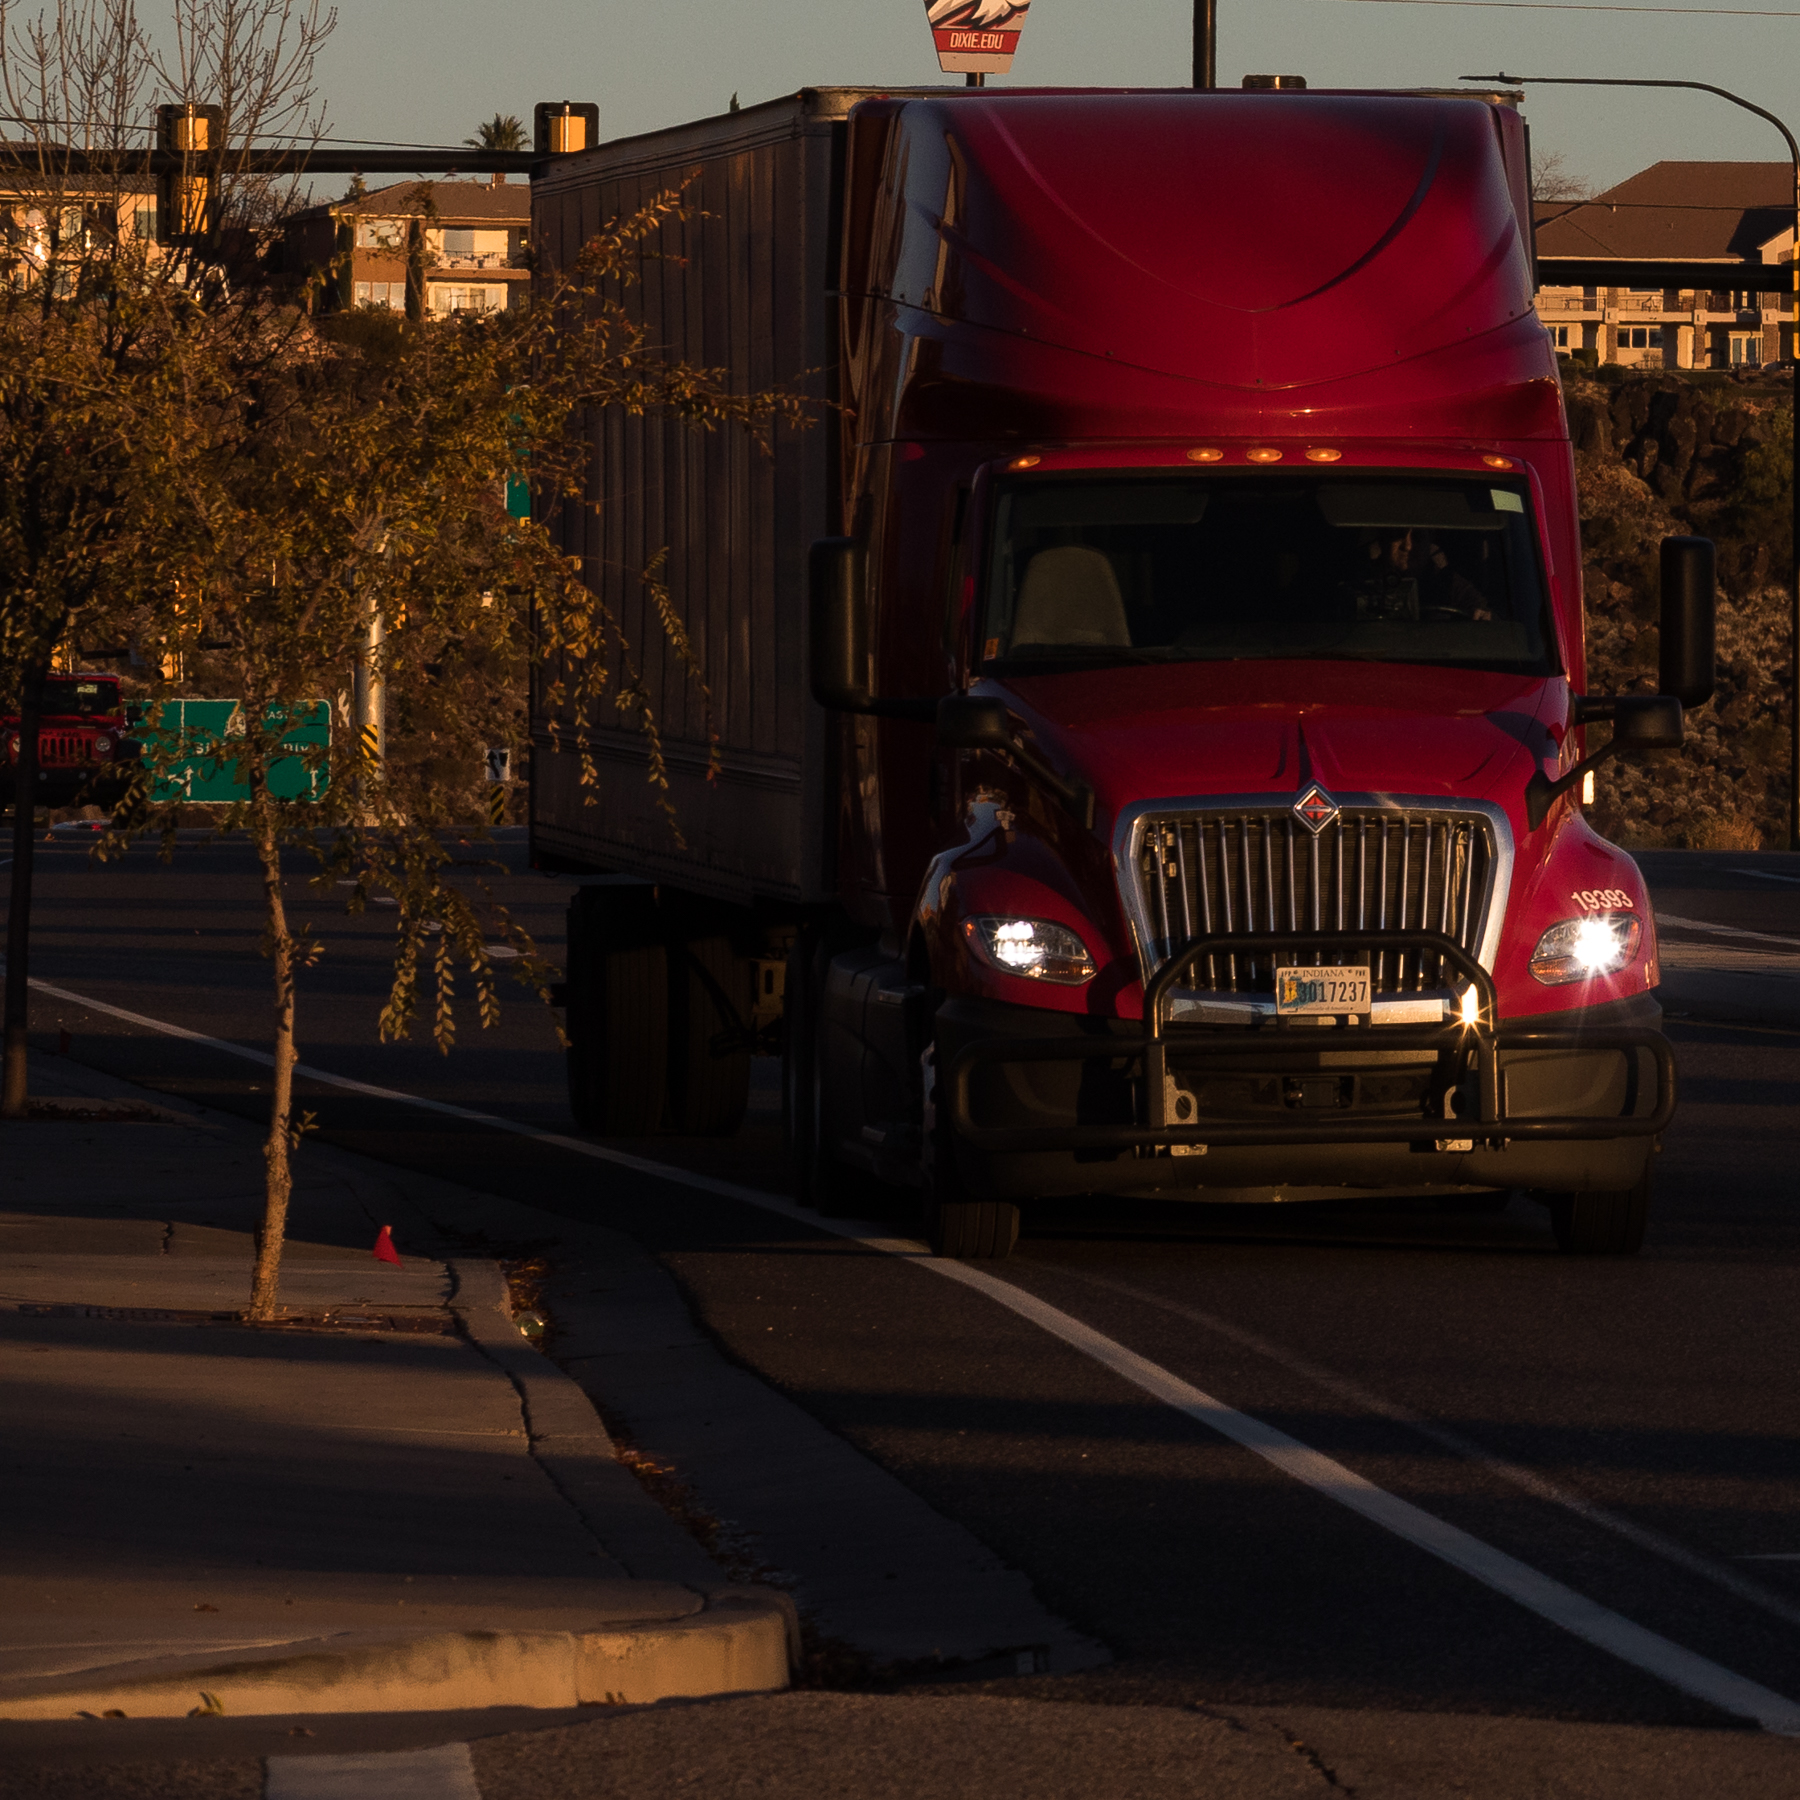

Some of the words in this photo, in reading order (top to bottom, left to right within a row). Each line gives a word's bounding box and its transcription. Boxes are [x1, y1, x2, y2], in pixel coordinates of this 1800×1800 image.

[949, 31, 1005, 49] DIXIE.EDU
[1570, 889, 1634, 911] 19393
[1303, 969, 1344, 978] INDIANA
[1299, 981, 1367, 1003] 3017237
